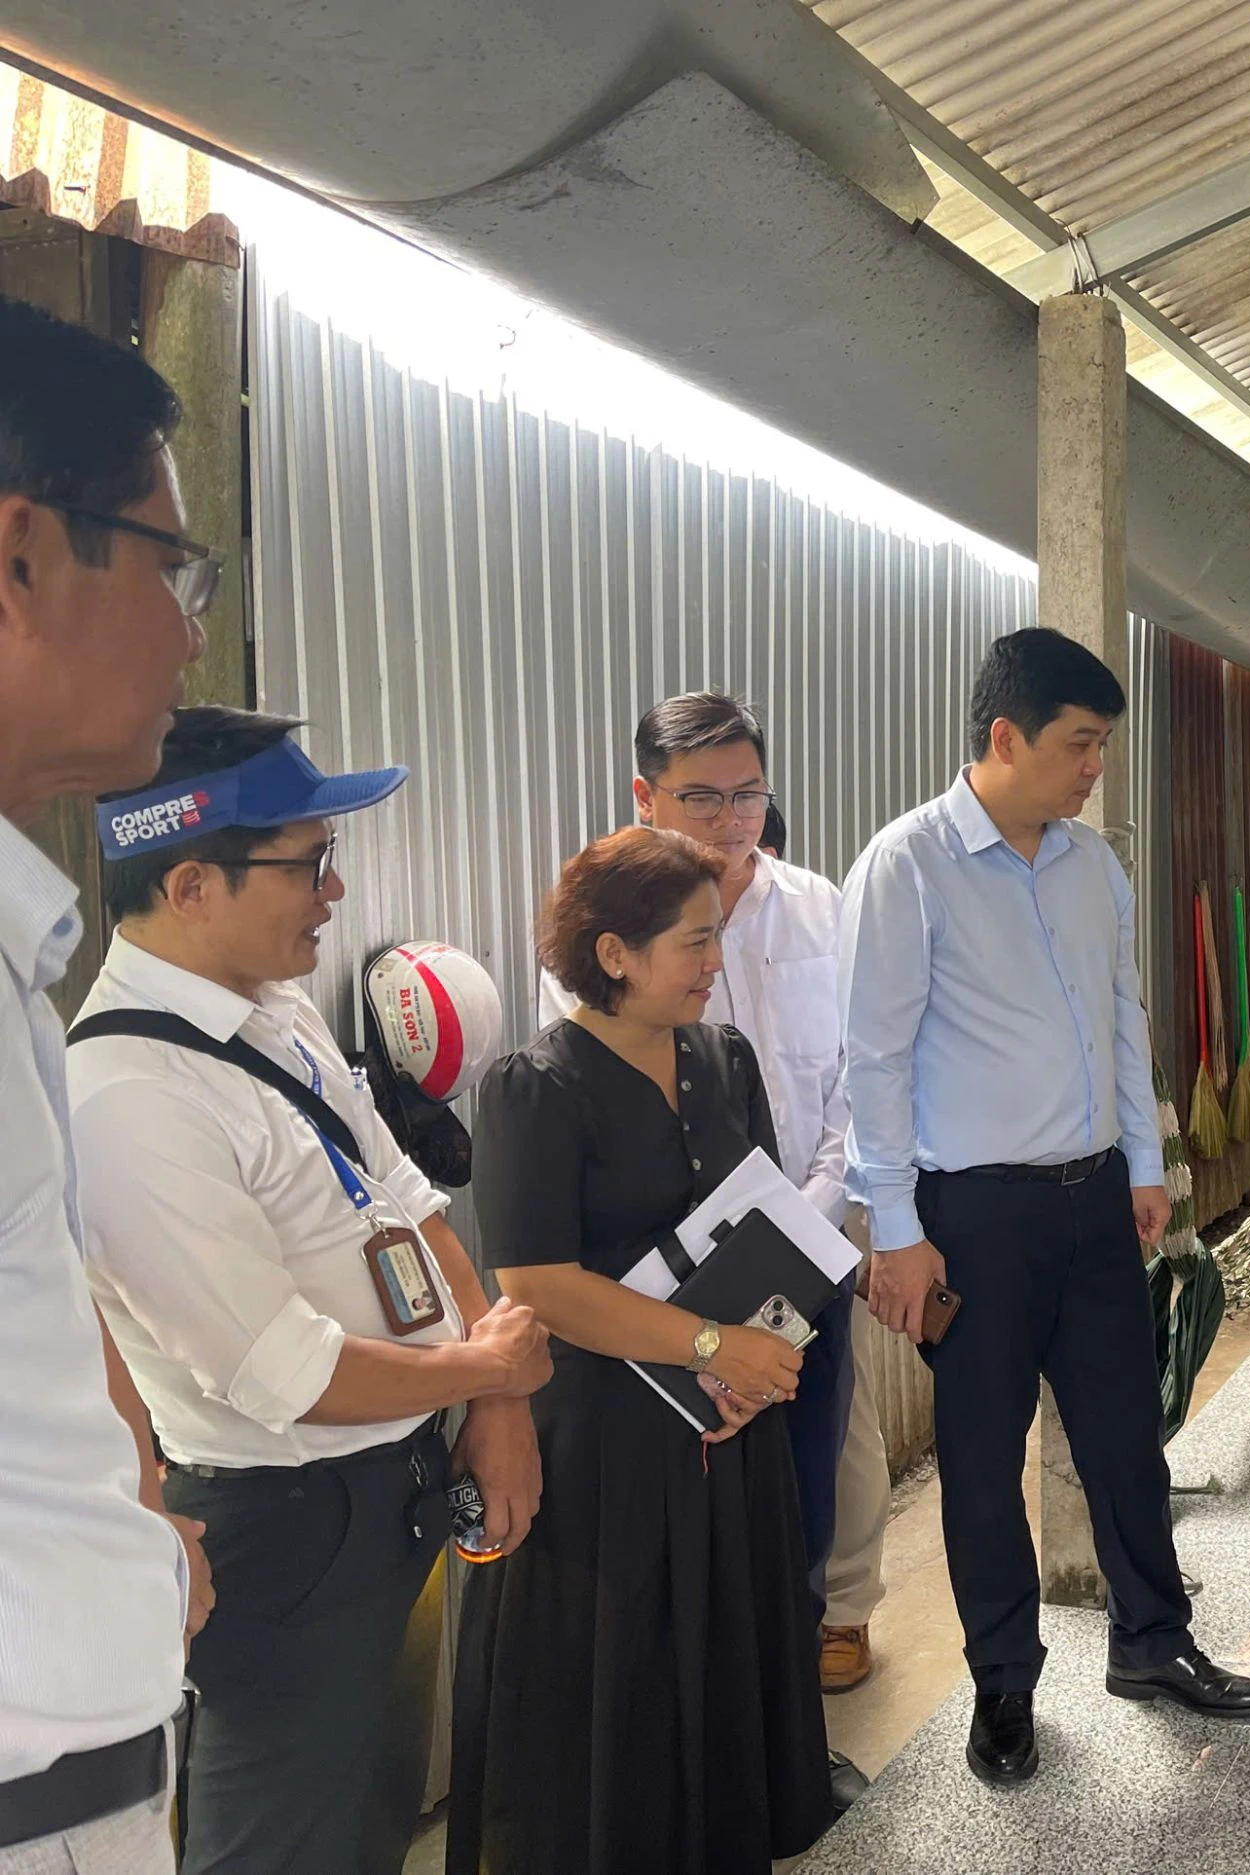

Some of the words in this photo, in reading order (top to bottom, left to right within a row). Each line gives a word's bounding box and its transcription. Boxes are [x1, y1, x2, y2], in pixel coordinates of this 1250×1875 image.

[115, 815, 181, 847] SPORT
[400, 988, 411, 1008] BA
[411, 1044, 423, 1053] 2
